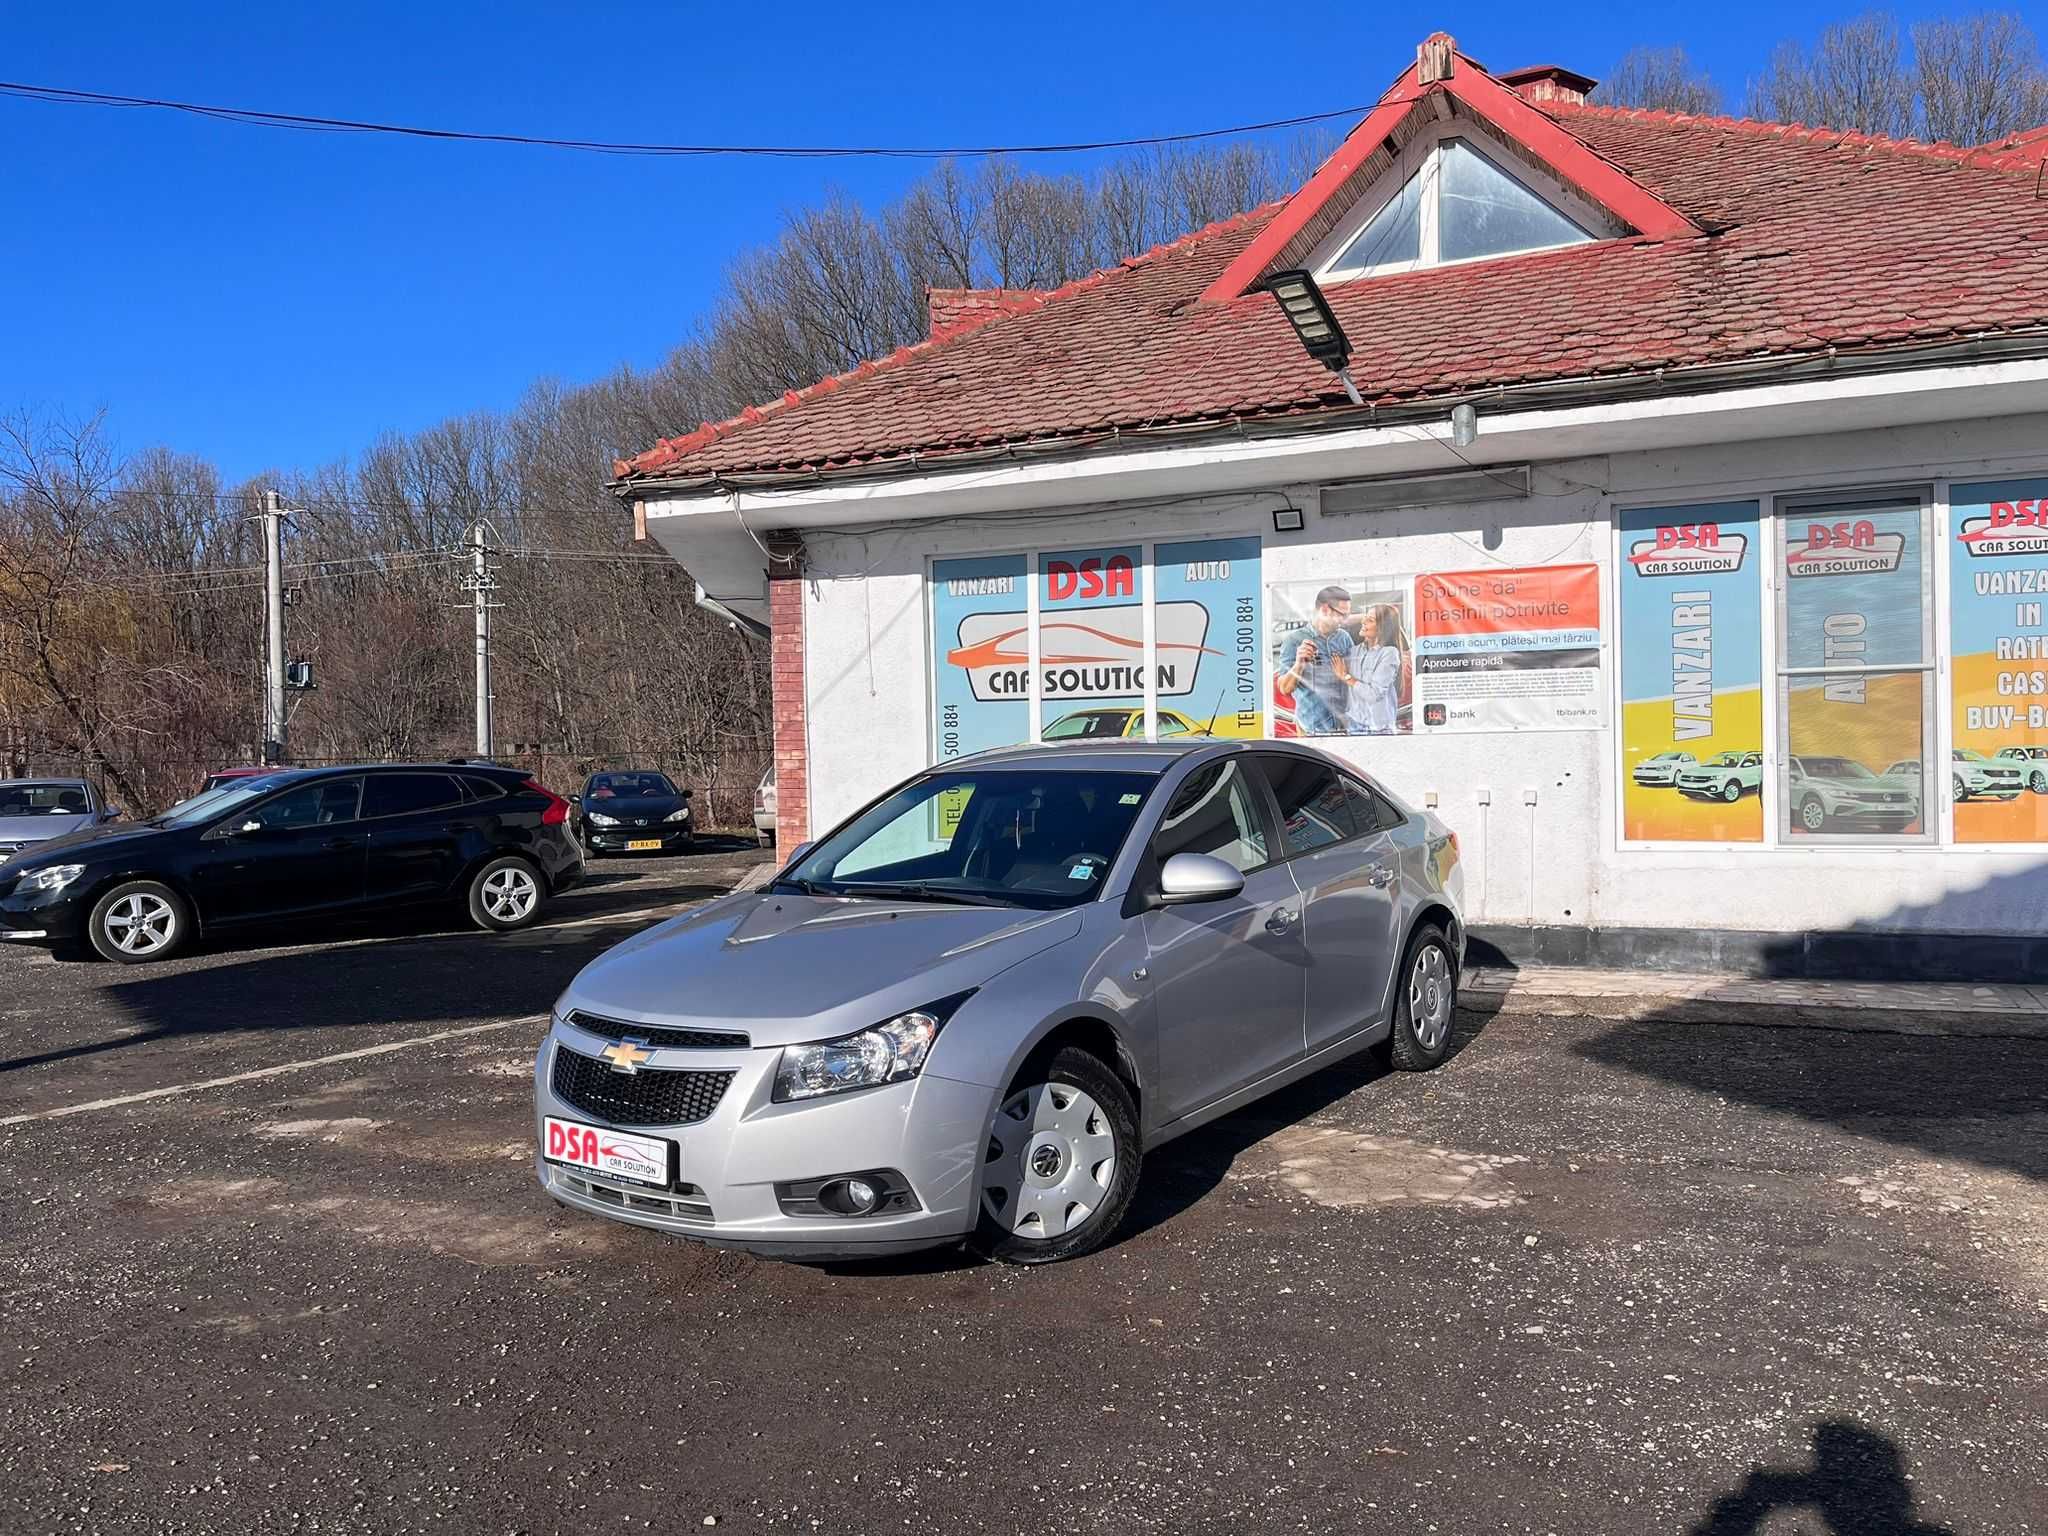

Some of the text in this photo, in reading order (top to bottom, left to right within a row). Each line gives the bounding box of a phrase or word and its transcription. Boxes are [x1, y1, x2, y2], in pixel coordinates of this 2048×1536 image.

[1655, 521, 1720, 549] DSA
[1808, 520, 1875, 549] DSA
[1979, 542, 2004, 552] CAR
[1185, 559, 1231, 582] AUTO
[1646, 559, 1731, 573] CAR SOLUTION
[1797, 558, 1889, 573] CAR SOLUTION
[948, 576, 1014, 597] VANZARI
[1047, 554, 1134, 601] DSA
[1422, 583, 1481, 601] Spune
[1493, 601, 1569, 621] potrivite
[2016, 602, 2042, 627] IN
[1422, 639, 1465, 650] Cumperi
[1468, 639, 1498, 648] acum,
[1541, 634, 1561, 644] mai
[1236, 597, 1256, 728] TEL.: 0790 500 884
[1422, 657, 1468, 669] Aprobare
[1672, 590, 1713, 742] VANZARI
[1823, 612, 1867, 704] AUTO
[1998, 671, 2048, 696] CAS
[1450, 709, 1476, 719] bank
[1556, 708, 1597, 717] tbibank.ro
[1967, 704, 2048, 730] BUY-B
[943, 704, 959, 755] 500 884
[549, 1121, 598, 1166] DSA
[609, 1158, 622, 1168] CAR
[624, 1161, 656, 1175] SOLUTION
